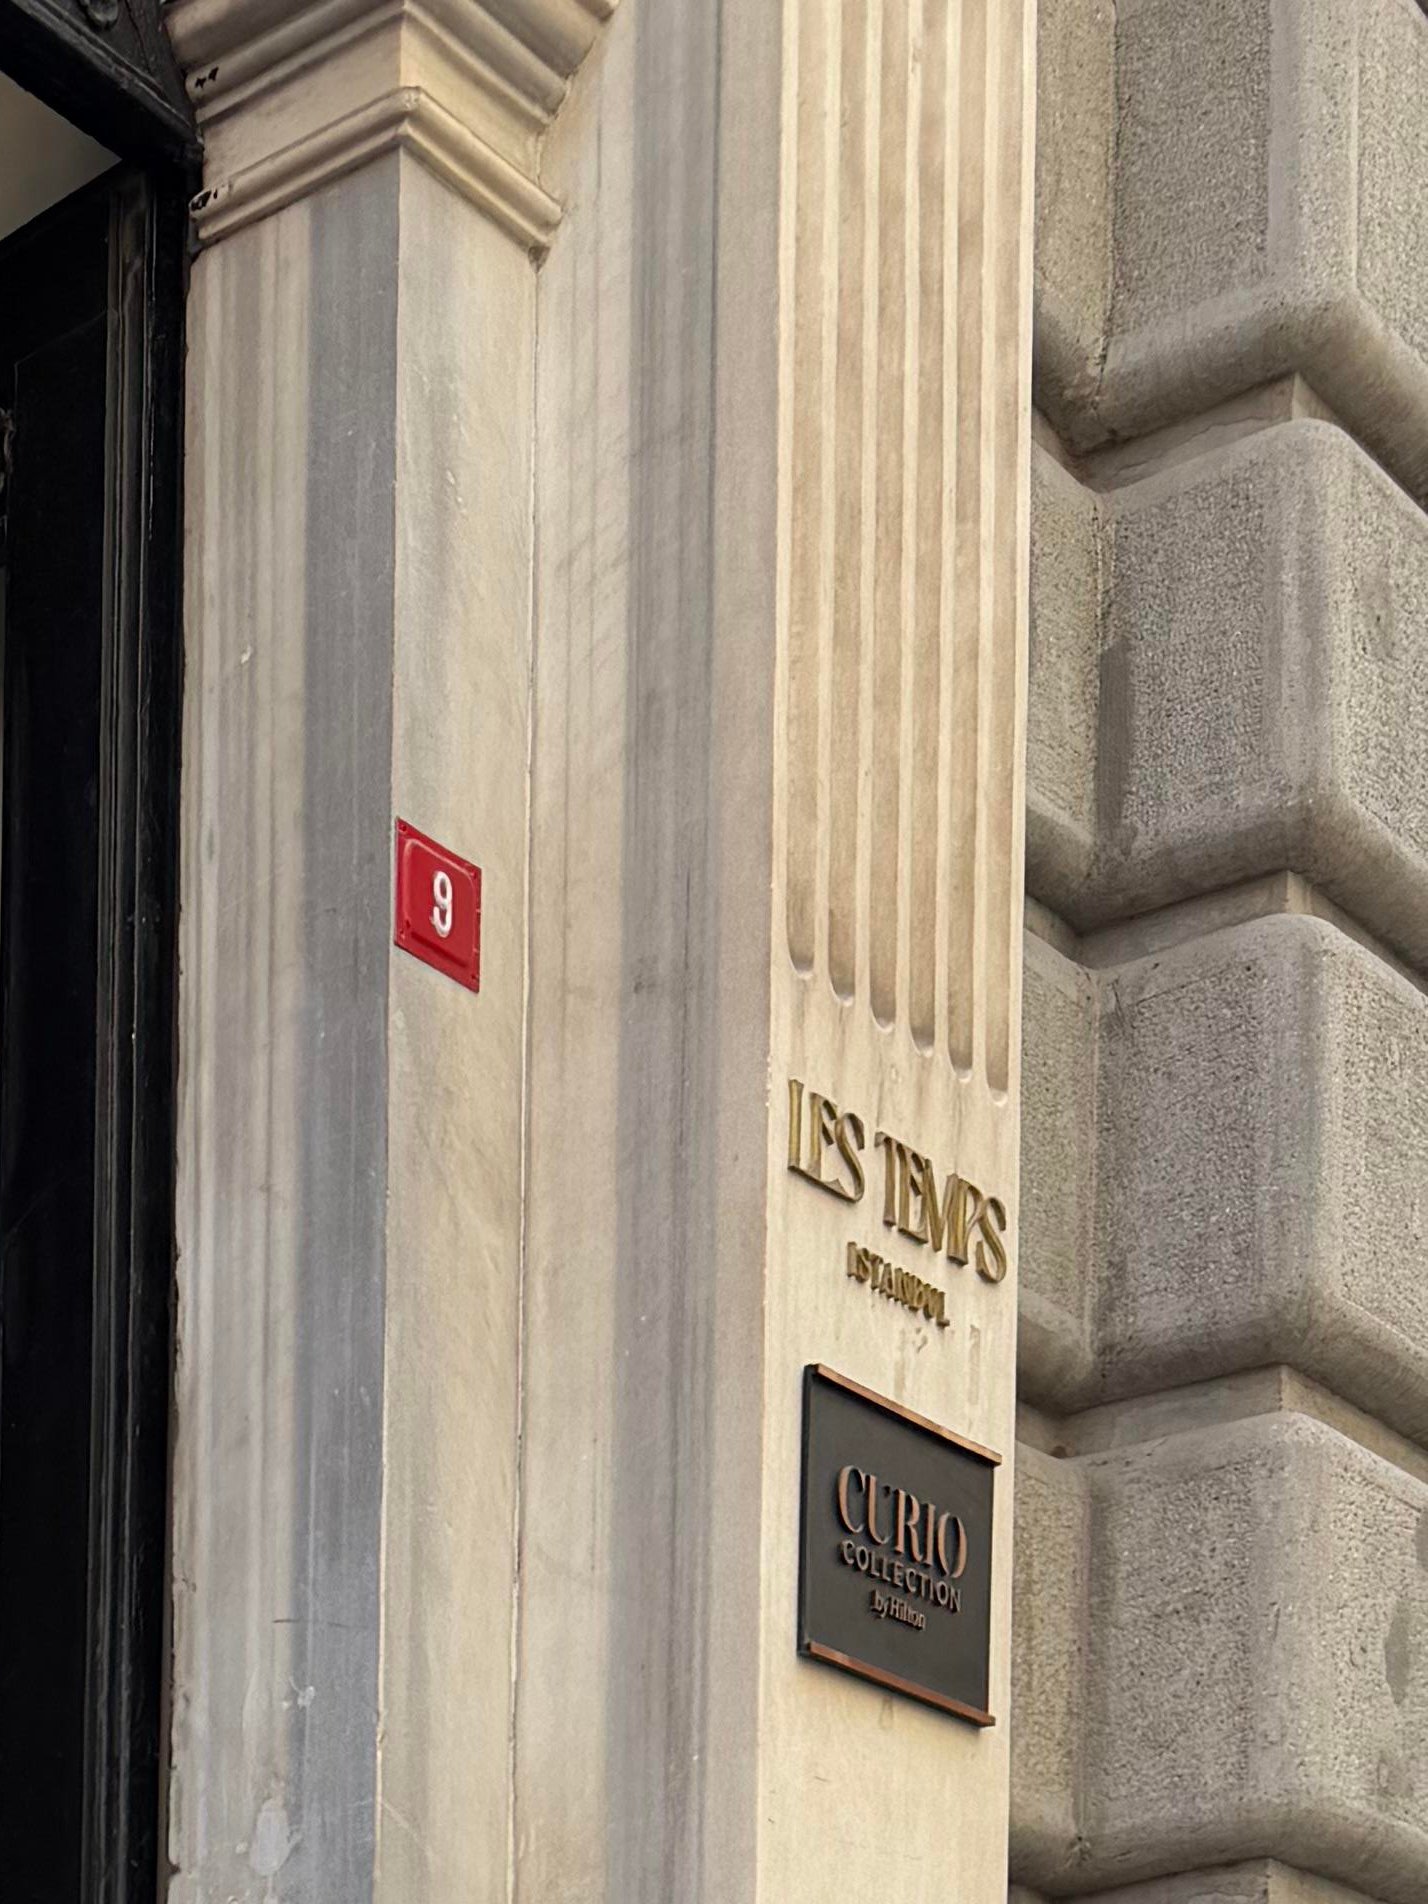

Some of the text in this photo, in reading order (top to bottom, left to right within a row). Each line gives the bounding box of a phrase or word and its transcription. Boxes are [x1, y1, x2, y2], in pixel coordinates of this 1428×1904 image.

[432, 870, 453, 938] 9
[787, 1079, 1007, 1283] LES TEMPS
[837, 1464, 968, 1578] CURIO
[841, 1539, 962, 1613] COLLECTION
[873, 1589, 926, 1631] by Hilton
